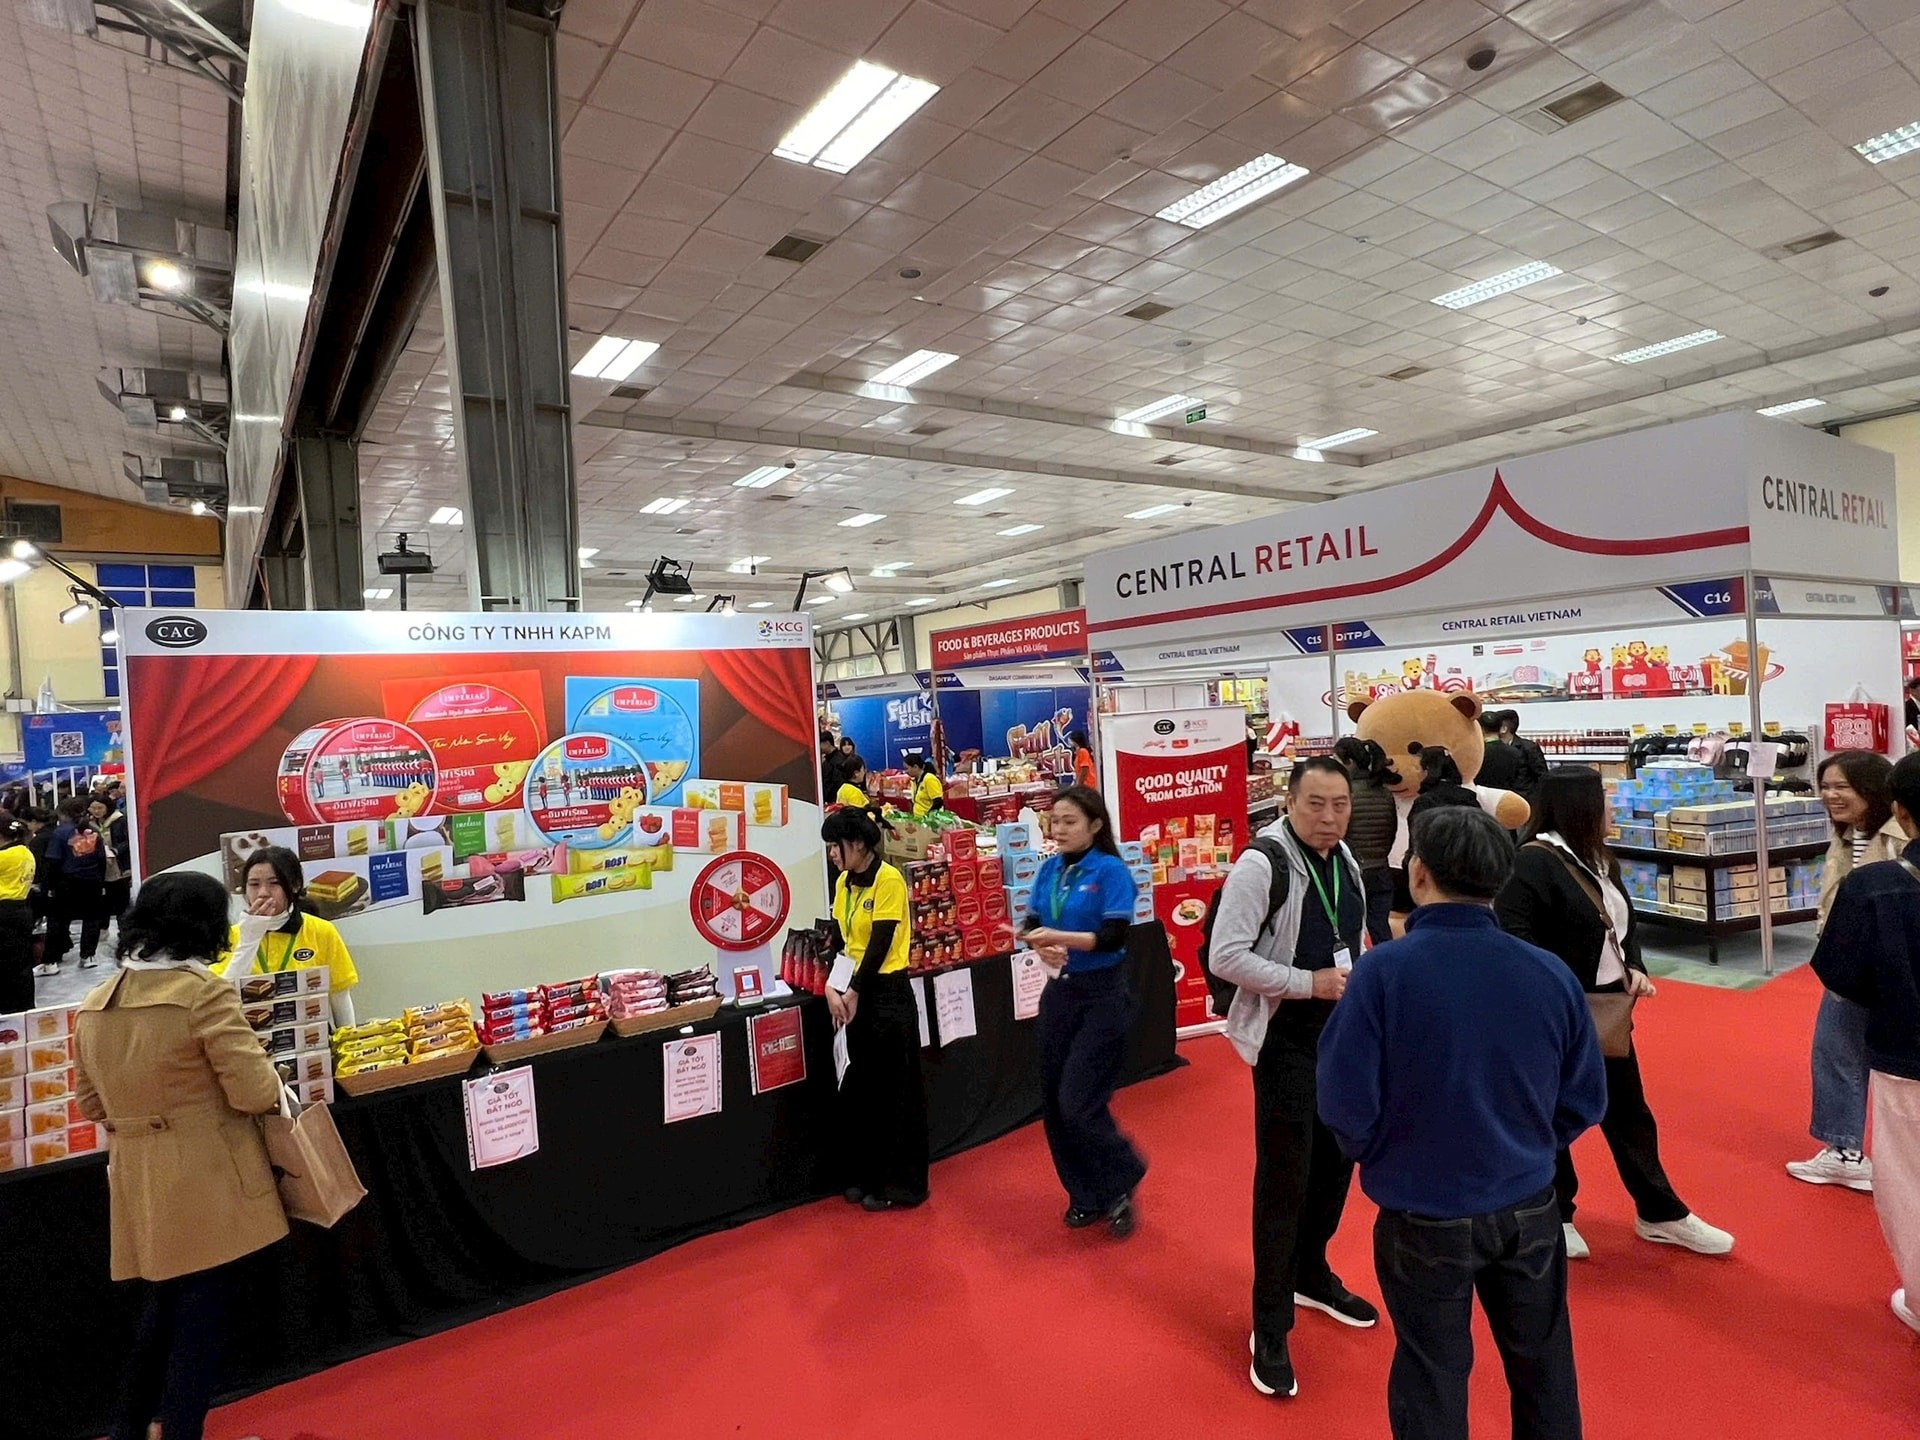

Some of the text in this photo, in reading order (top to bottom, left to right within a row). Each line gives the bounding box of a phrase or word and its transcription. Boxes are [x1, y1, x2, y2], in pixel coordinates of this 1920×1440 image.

[1762, 475, 1888, 529] CENTRAL RETAIL
[1116, 525, 1379, 599] CENTRAL RETAIL
[1703, 591, 1732, 605] C16
[775, 621, 803, 632] KCG
[1442, 608, 1582, 631] CENTRAL RETAIL VIETNAM
[157, 625, 195, 639] CAC
[407, 622, 612, 641] CÔNG TY TNHH KAPM
[937, 620, 1080, 652] FOOD & BEVERAGES PRODUCTS
[1335, 632, 1362, 642] DITP
[1306, 635, 1322, 645] C15
[1158, 651, 1186, 660] CENTRAL
[1208, 644, 1240, 655] VIETNAM
[444, 692, 486, 702] IMPERIAL
[886, 695, 919, 723] Full
[355, 732, 393, 740] IMPERIAL
[568, 747, 605, 755] IMPERIAL
[1135, 765, 1228, 795] GOOD QUALITY
[1143, 782, 1223, 803] FROM CREATION
[604, 855, 628, 869] ROSY
[585, 876, 608, 892] ROSY
